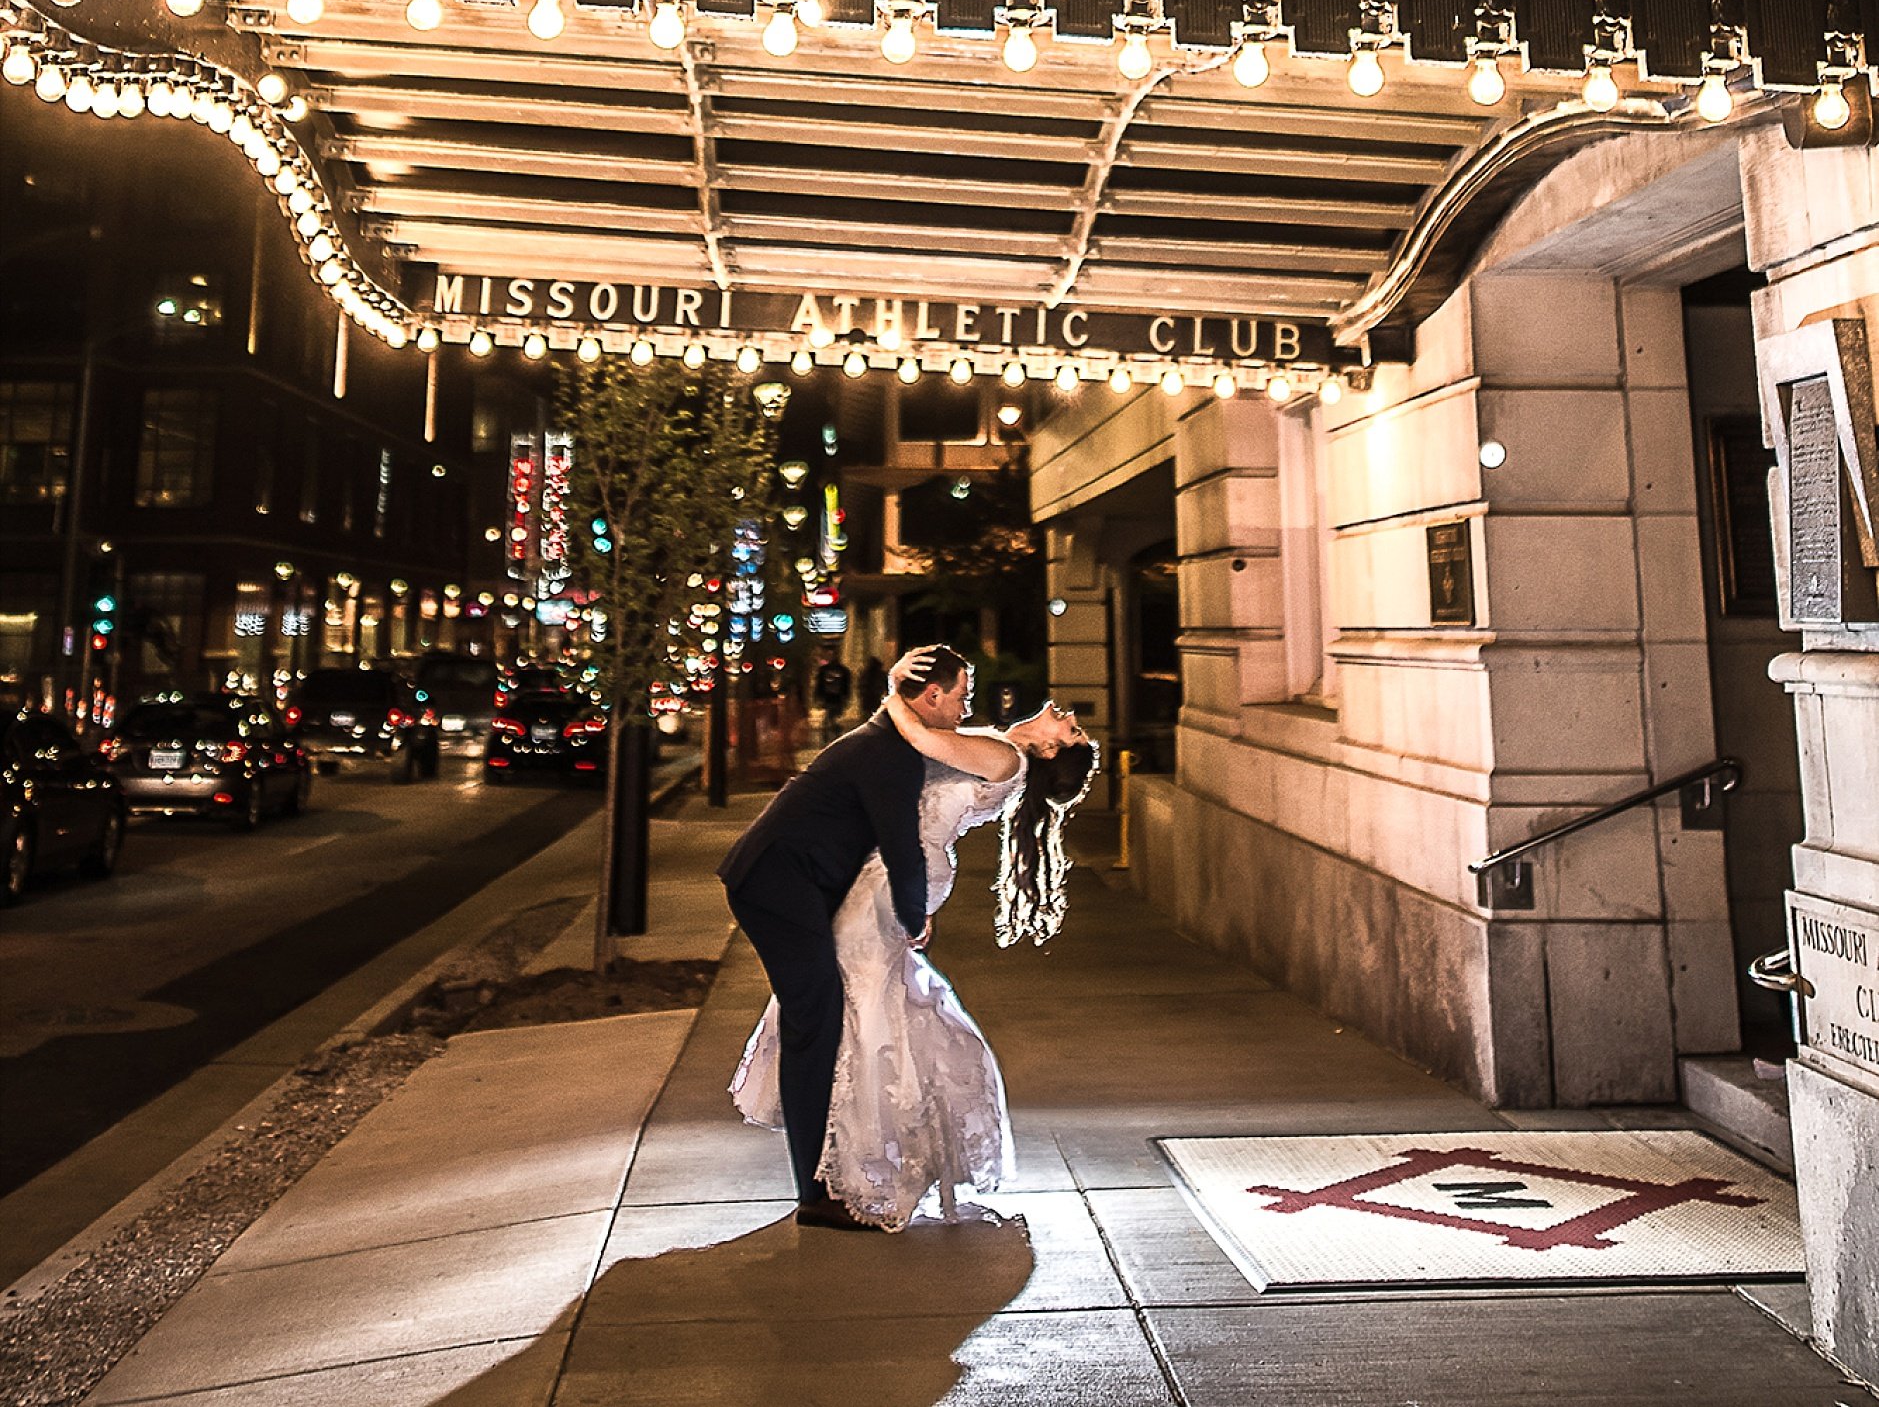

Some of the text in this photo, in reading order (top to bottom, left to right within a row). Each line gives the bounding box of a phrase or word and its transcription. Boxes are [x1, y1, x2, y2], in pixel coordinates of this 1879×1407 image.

[433, 275, 1301, 361] MISSOURI ATHLETIC CLUB
[1802, 915, 1868, 967] MISSOURI
[1432, 1181, 1554, 1209] M
